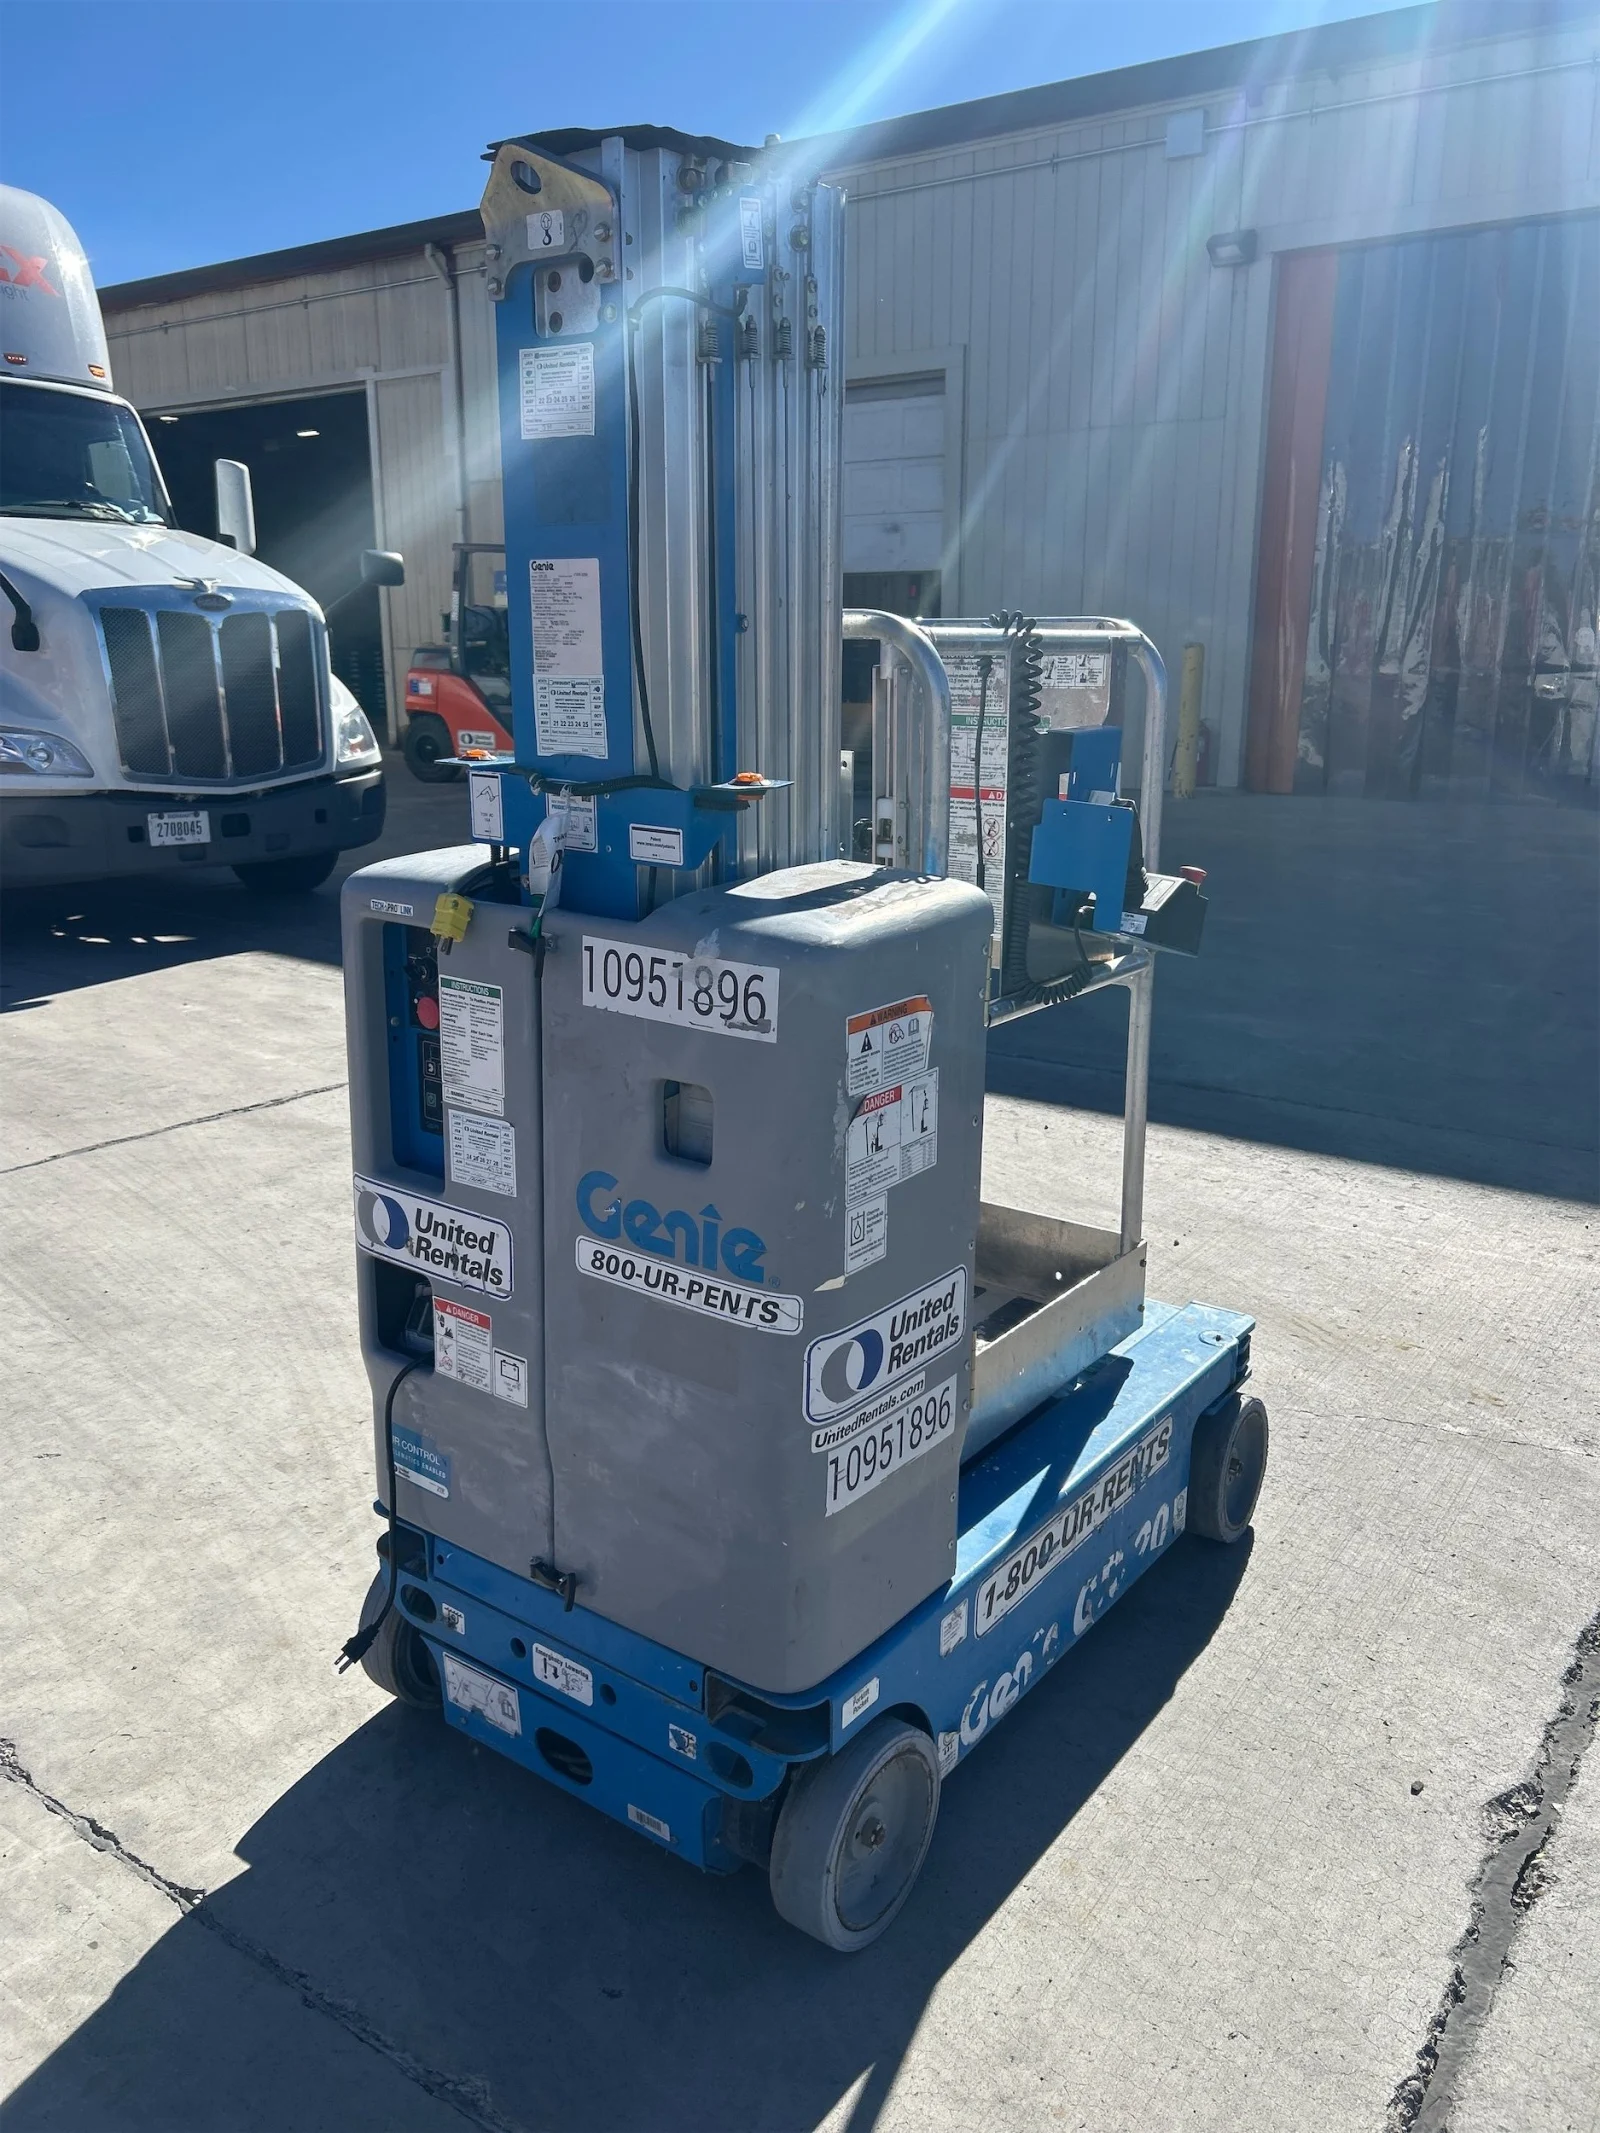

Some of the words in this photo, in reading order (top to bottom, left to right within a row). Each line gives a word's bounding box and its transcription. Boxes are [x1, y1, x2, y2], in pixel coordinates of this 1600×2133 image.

[531, 561, 554, 571] Genie
[157, 821, 202, 838] 2708045
[451, 981, 489, 996] INSTRUCTIONS
[584, 946, 766, 1025] 10951896
[878, 1004, 908, 1020] WARNING
[864, 1090, 895, 1112] DANGER
[415, 1208, 495, 1256] United
[576, 1170, 767, 1284] Genie
[416, 1235, 503, 1286] Rentals
[453, 1306, 479, 1324] DANGER
[890, 1282, 956, 1342] United
[887, 1312, 959, 1374] Rentals
[815, 1378, 924, 1448] UnitedRentals.com
[402, 1440, 440, 1466] CONTROL
[829, 1386, 950, 1501] 10951896
[422, 1462, 446, 1479] ENABLED
[985, 1426, 1170, 1620] 1-800-UR-RENTS
[536, 1647, 563, 1667] Emergency
[565, 1662, 588, 1680] Lowering
[853, 1688, 869, 1706] Forklift
[853, 1697, 869, 1714] Pocket
